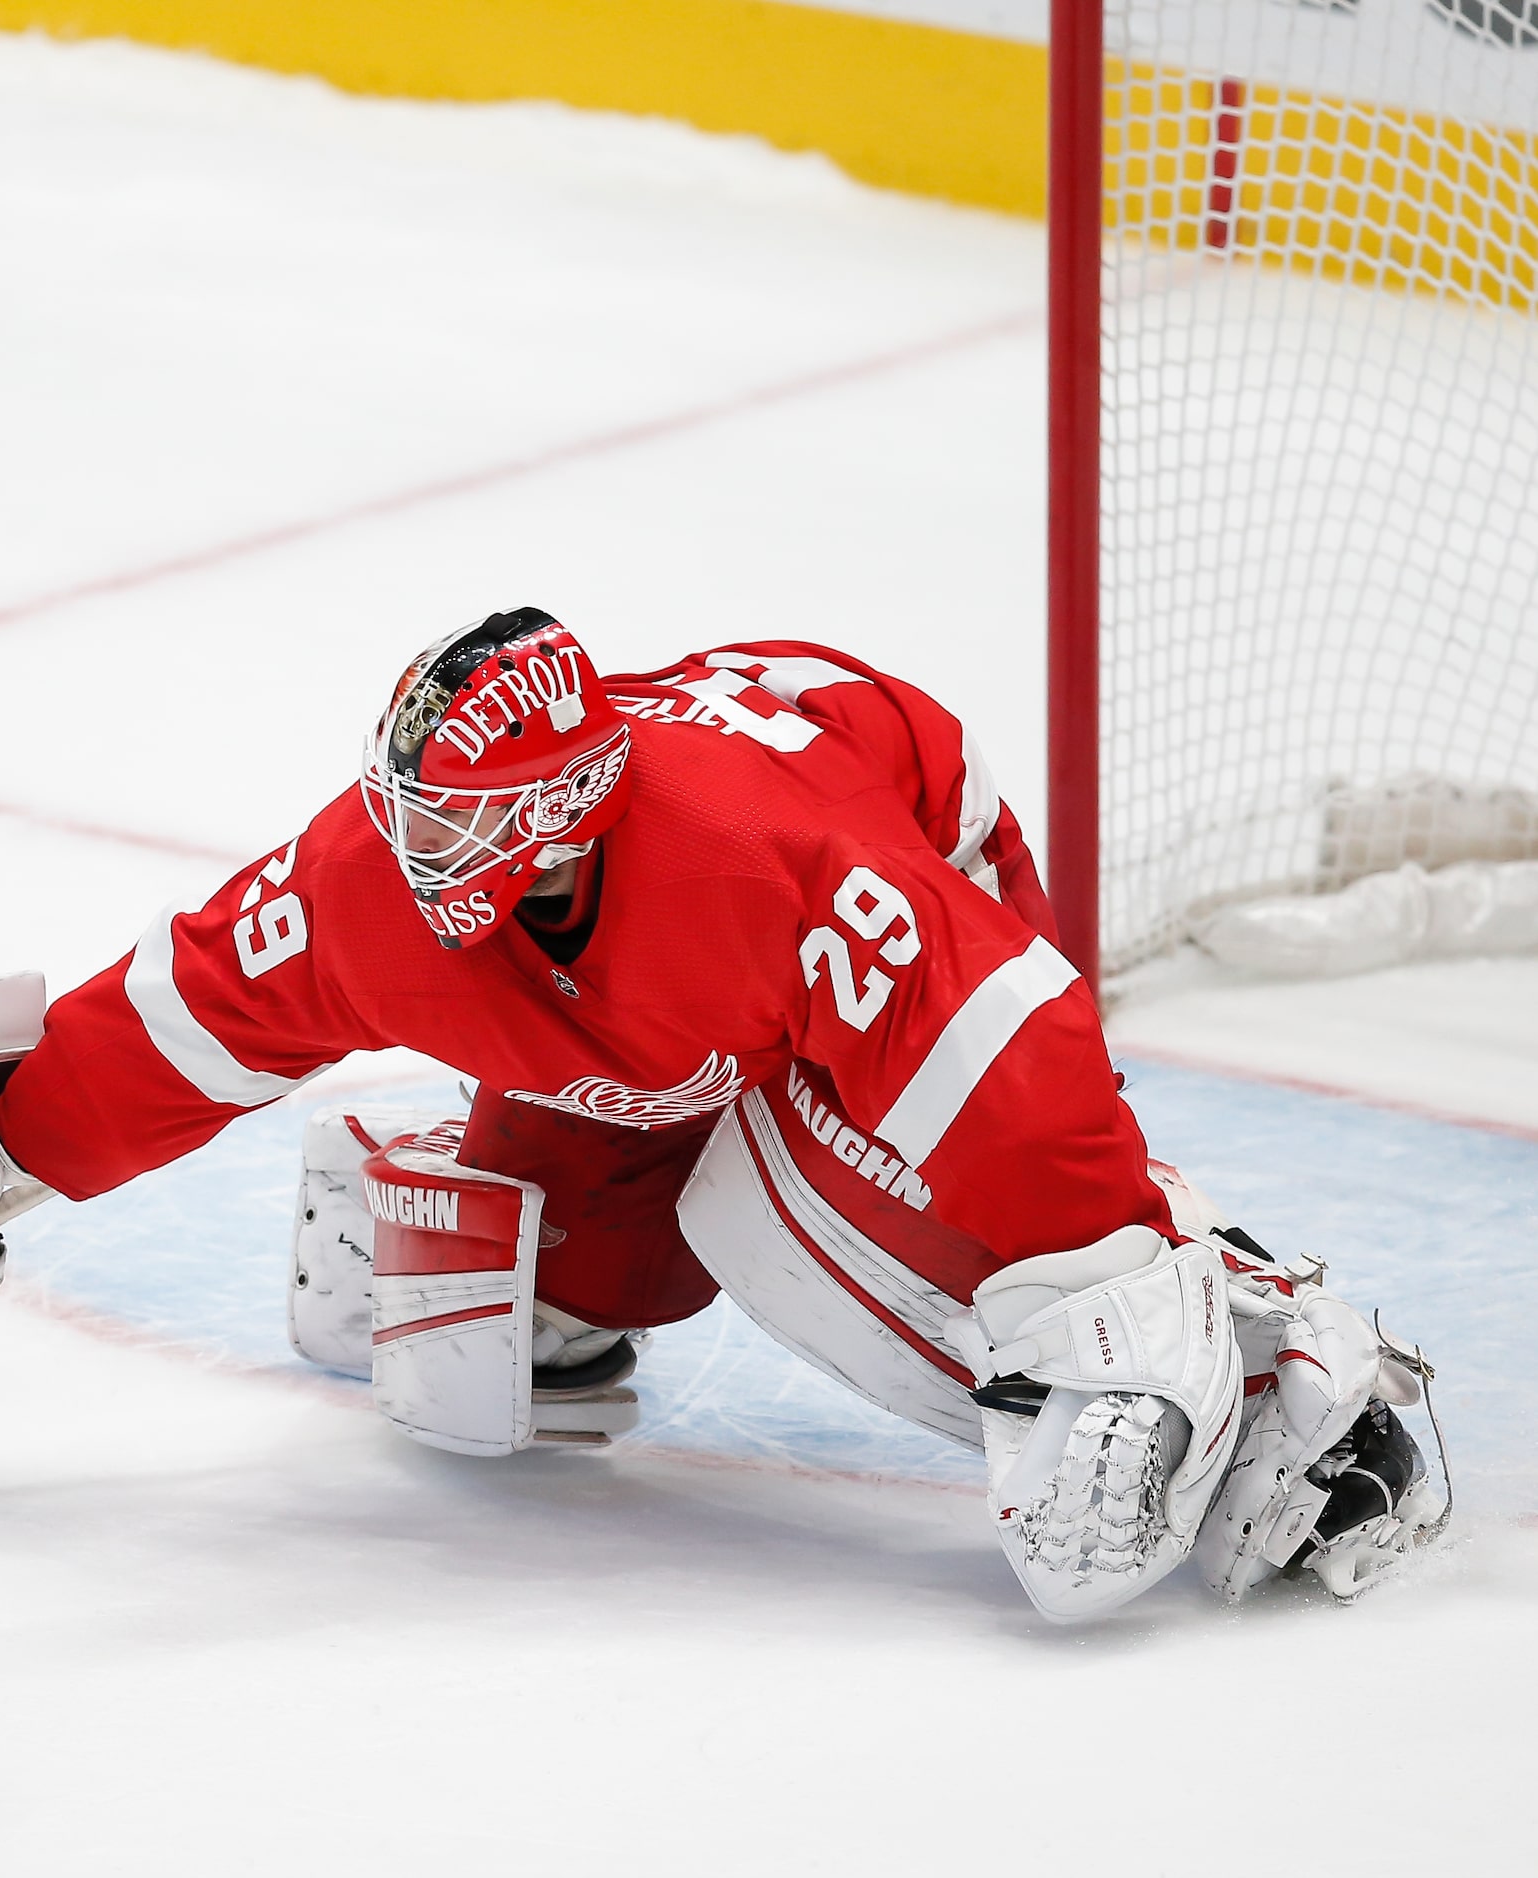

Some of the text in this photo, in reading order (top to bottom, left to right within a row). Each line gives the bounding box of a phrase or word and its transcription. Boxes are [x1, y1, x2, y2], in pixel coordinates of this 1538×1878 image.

[433, 645, 583, 766] DETROIT
[232, 834, 309, 981] 29
[797, 864, 923, 1034] 29
[787, 1060, 933, 1213] VAUGHN
[363, 1177, 460, 1232] VAUGHN
[1094, 1316, 1114, 1367] GREISS
